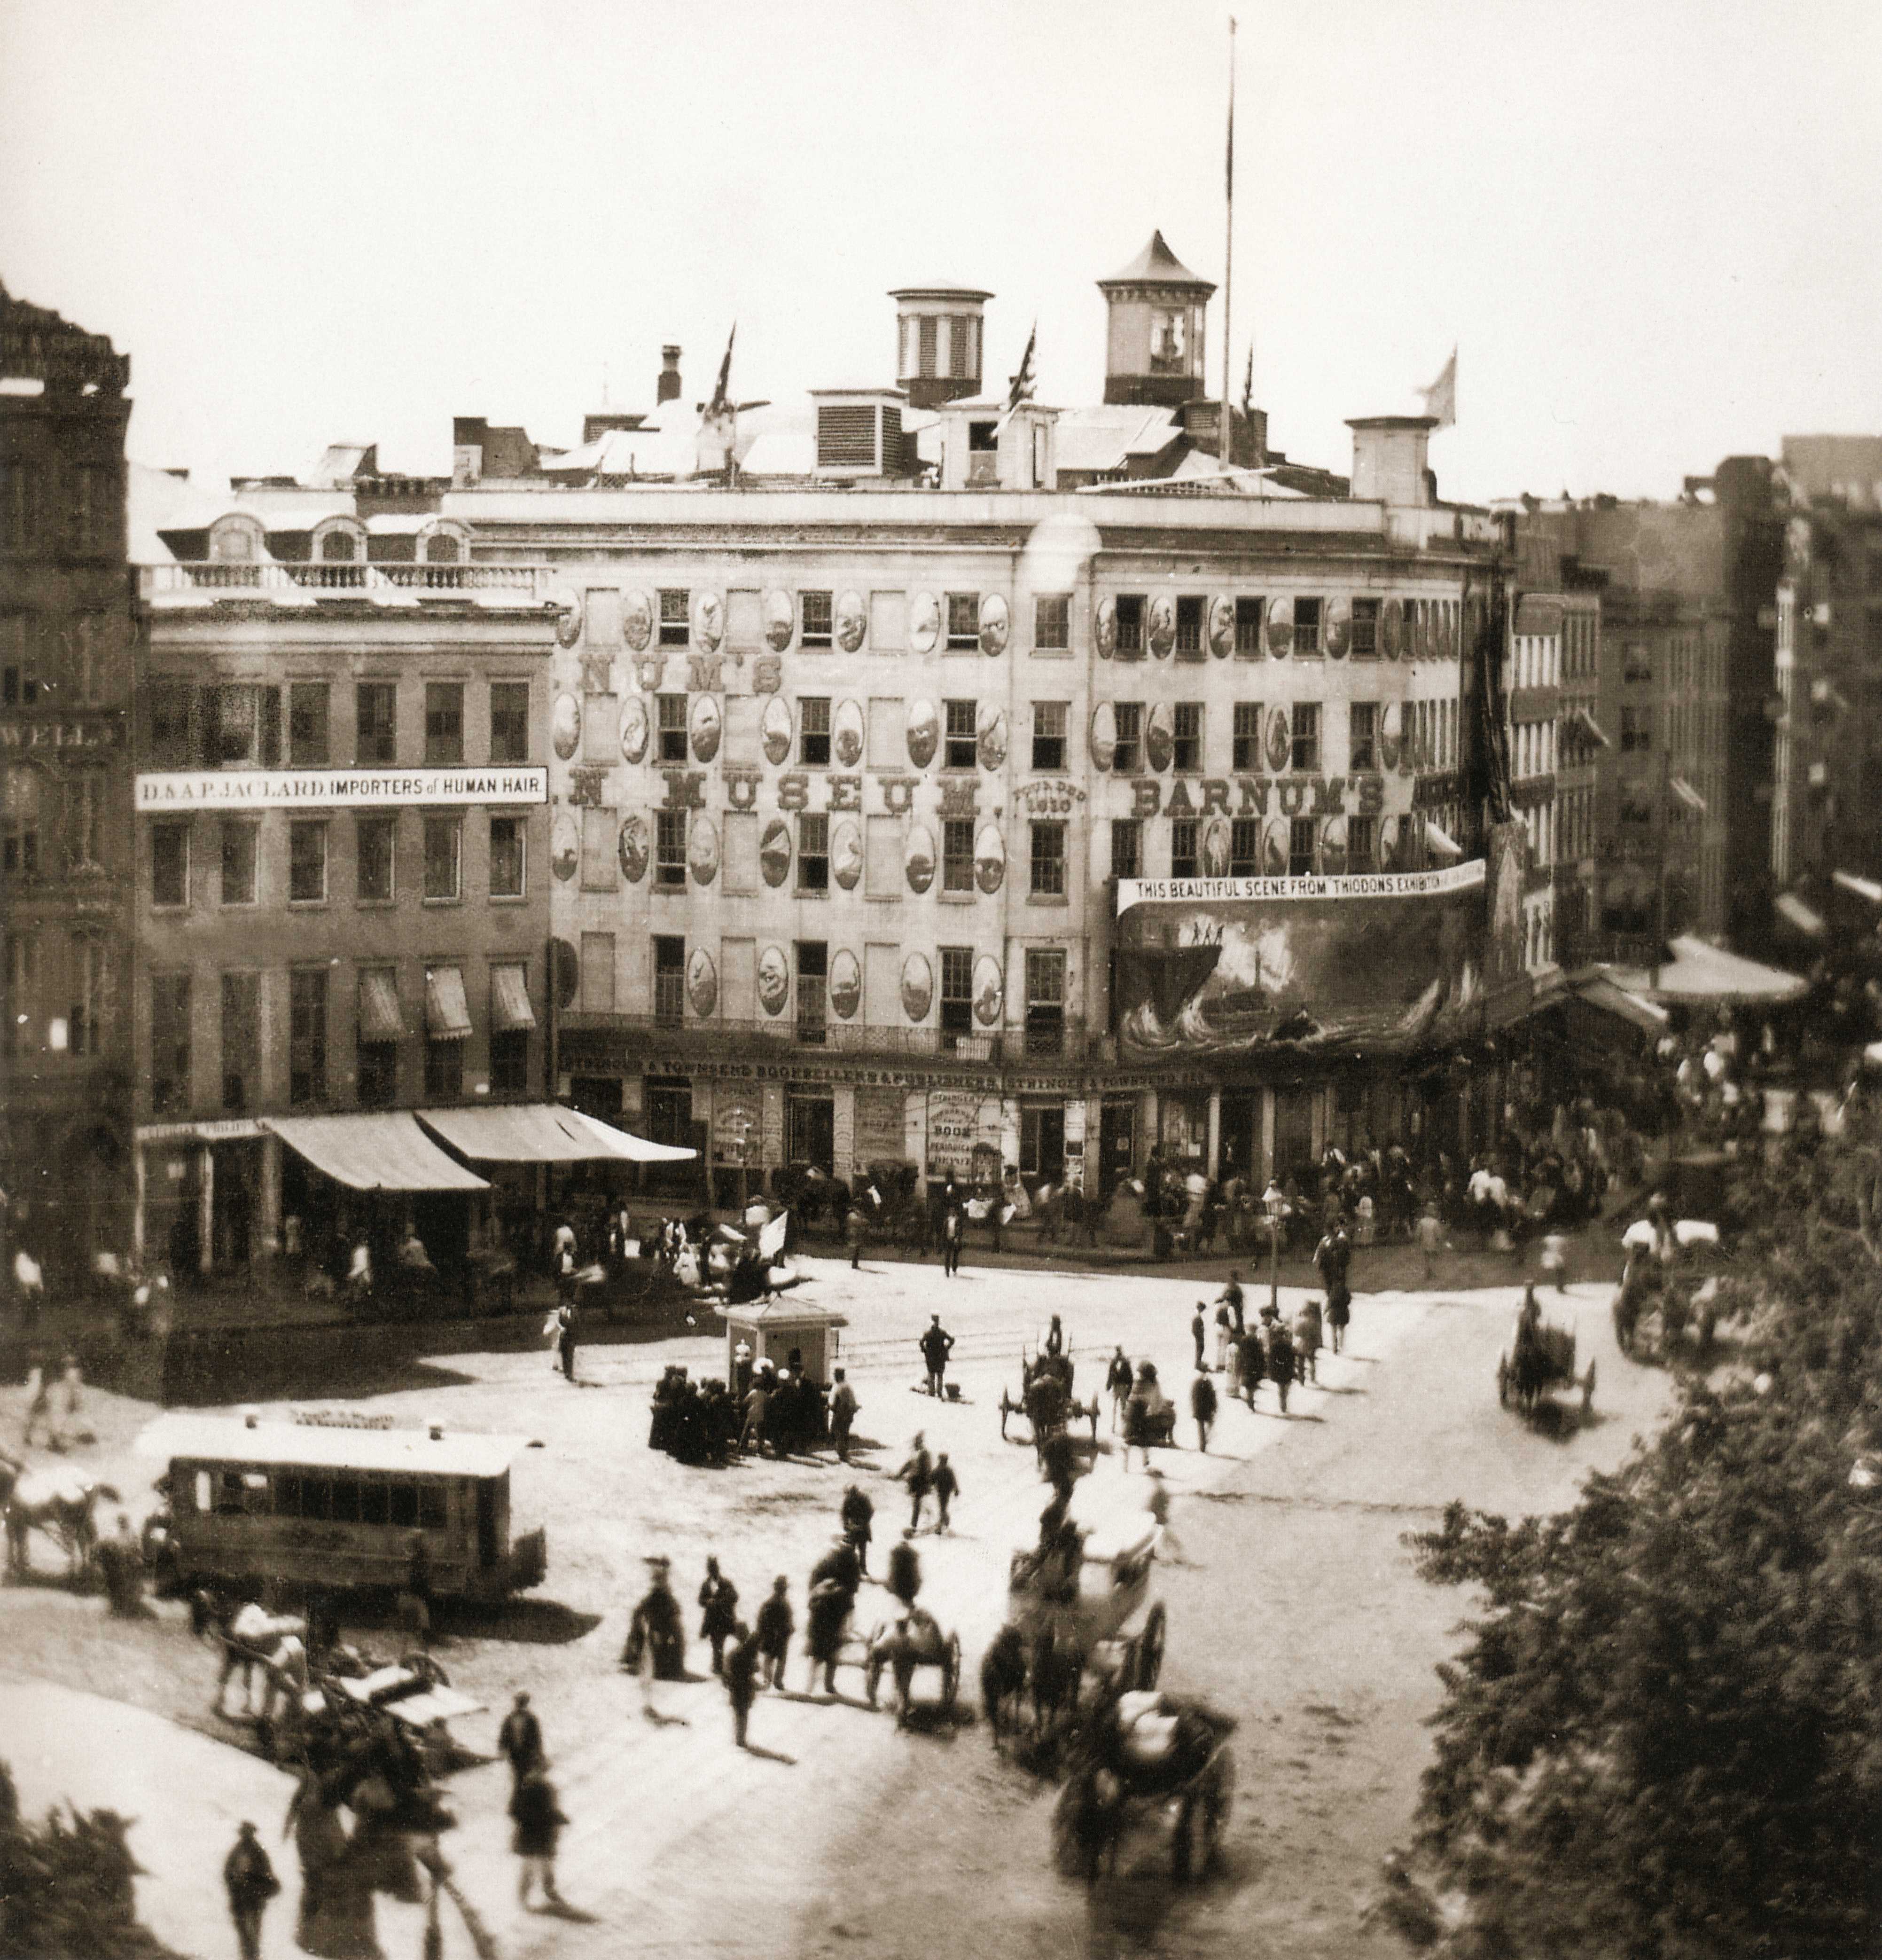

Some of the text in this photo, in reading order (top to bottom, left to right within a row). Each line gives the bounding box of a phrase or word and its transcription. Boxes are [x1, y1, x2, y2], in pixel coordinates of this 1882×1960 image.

[330, 778, 422, 795] IMPORTERS
[444, 777, 496, 794] HUMAN
[1131, 776, 1384, 817] BARNUM'S
[1137, 881, 1166, 898] THIS
[1170, 881, 1240, 898] BEAUTIFUL
[1245, 880, 1286, 896] SCENE
[1291, 878, 1326, 895] FROM
